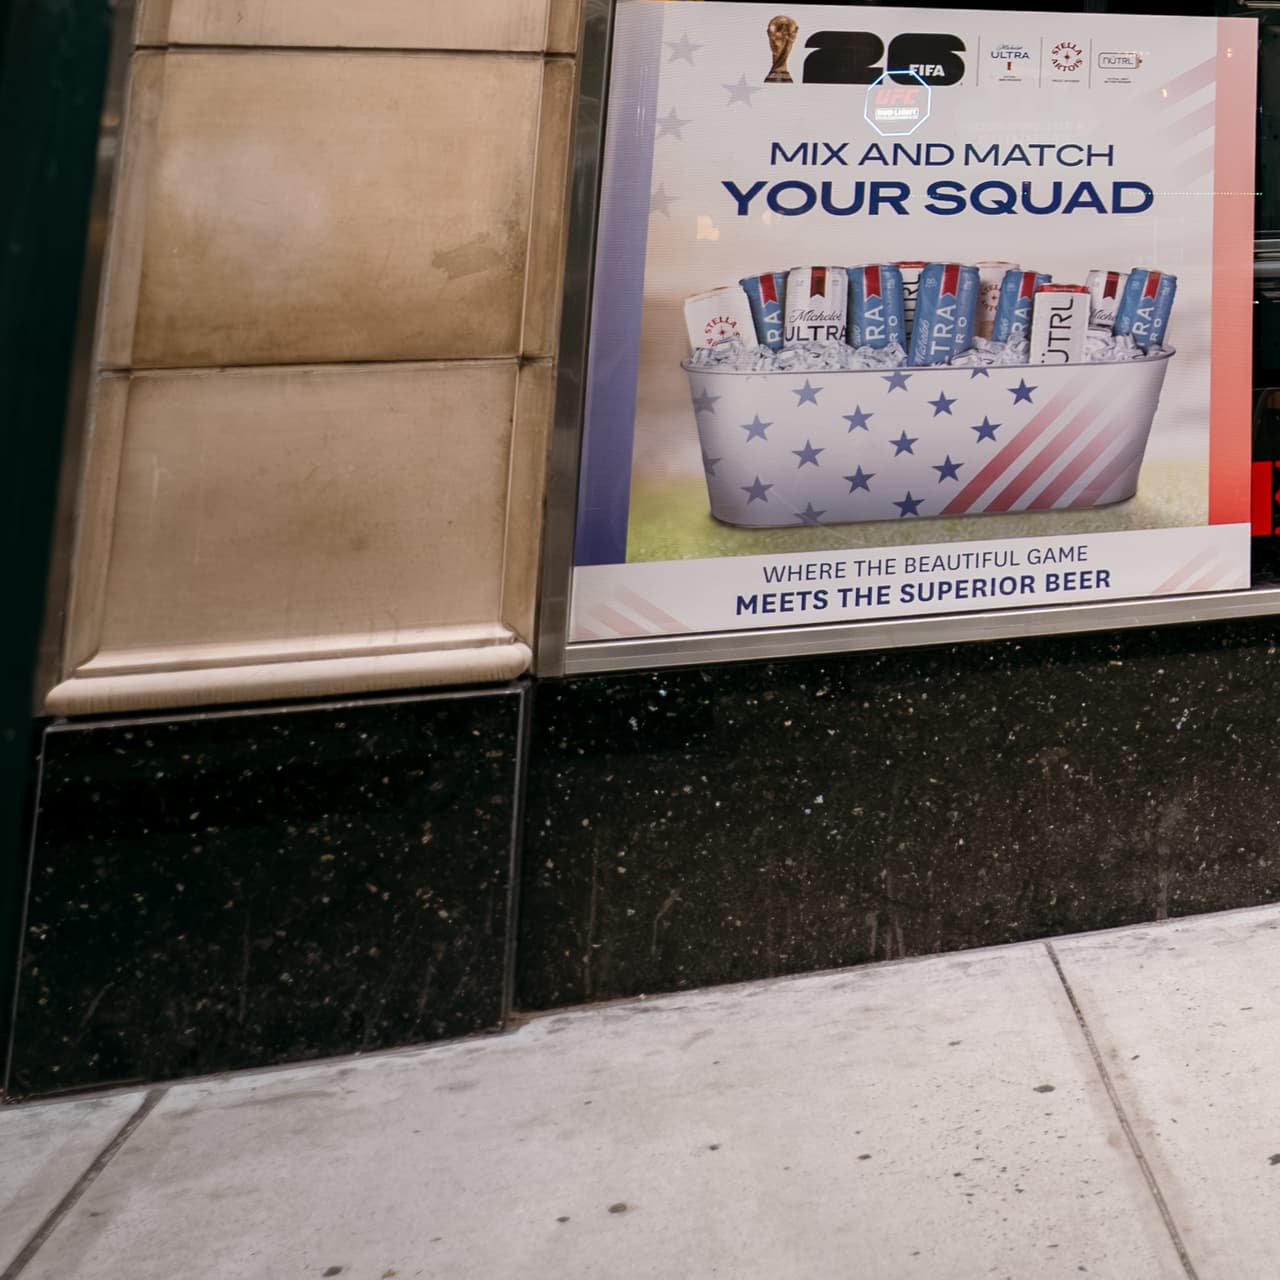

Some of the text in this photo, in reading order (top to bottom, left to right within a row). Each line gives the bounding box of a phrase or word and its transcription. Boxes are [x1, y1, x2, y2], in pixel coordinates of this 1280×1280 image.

[991, 51, 1030, 59] ULTRA
[1051, 42, 1083, 56] STELLA
[909, 64, 945, 78] FIFA
[1051, 58, 1083, 72] ARTOIS
[770, 142, 1114, 167] MIX AND MATCH
[721, 180, 1155, 216] YOUR SQUAD
[785, 325, 848, 342] ULTRA
[763, 545, 1089, 584] WHERE THE BEAUTIFUL GAME
[736, 569, 1111, 616] MEETS THE SUPERIOR BEER
